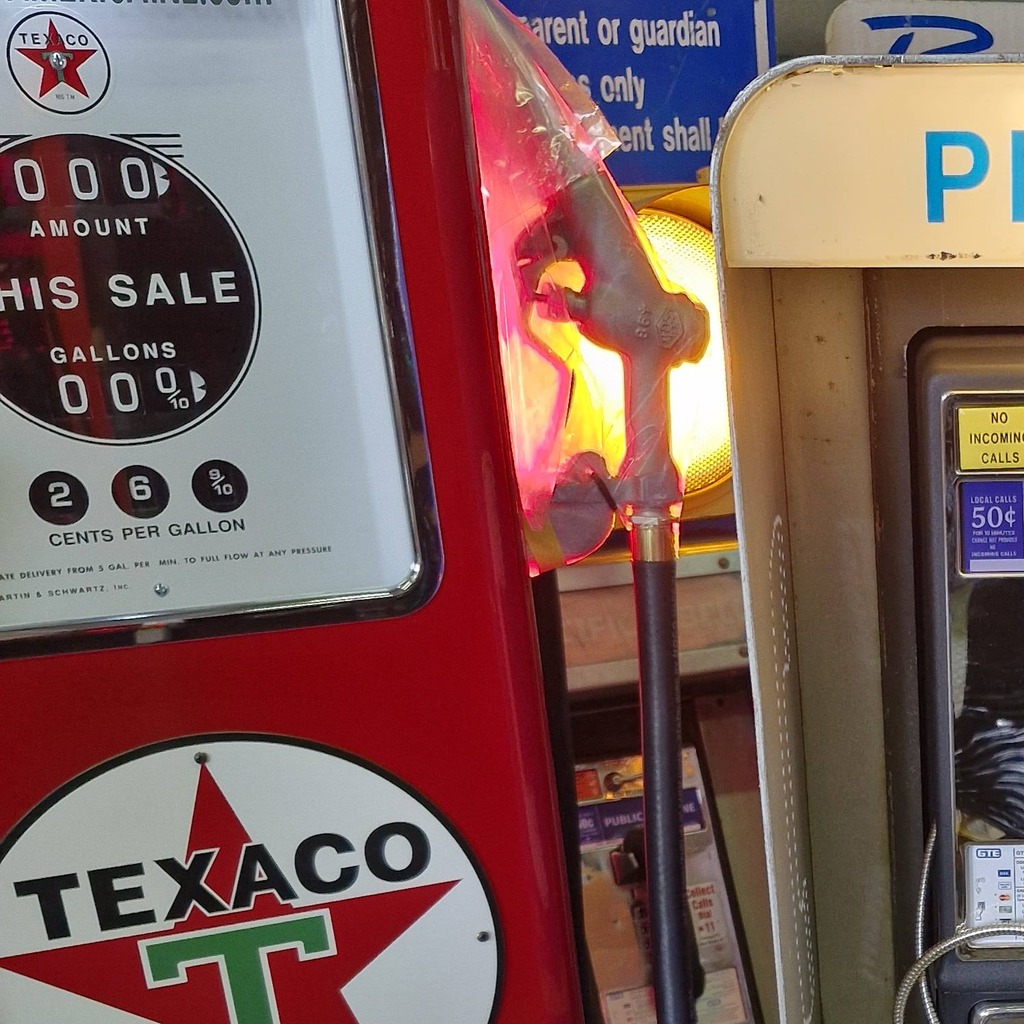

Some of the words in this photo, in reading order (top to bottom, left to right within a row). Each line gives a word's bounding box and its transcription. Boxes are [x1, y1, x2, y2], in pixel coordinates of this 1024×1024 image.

[18, 33, 89, 46] TEXACO
[597, 16, 621, 46] or
[629, 10, 720, 54] guardian
[601, 66, 645, 110] only
[662, 116, 712, 152] shall
[30, 217, 150, 238] AMOUNT
[108, 271, 240, 308] SALE
[50, 341, 178, 364] GALLONS
[990, 411, 1008, 424] NO
[981, 452, 1020, 464] CALLS
[47, 481, 73, 508] 2
[128, 475, 152, 501] 6
[970, 496, 993, 504] LOCAL
[994, 495, 1017, 503] CALLS
[971, 505, 1016, 528] 50¢
[48, 529, 114, 547] CENTS
[122, 524, 161, 541] PER
[168, 518, 246, 537] GALLON
[20, 568, 62, 579] DELIVERY
[67, 566, 94, 575] FROM
[200, 555, 220, 563] FULL
[224, 553, 249, 561] FLOW
[268, 549, 287, 557] ANY
[291, 546, 332, 555] PRESSURE
[604, 812, 643, 827] PUBLIC
[978, 848, 1001, 858] GTE
[13, 821, 432, 941] TEXACO
